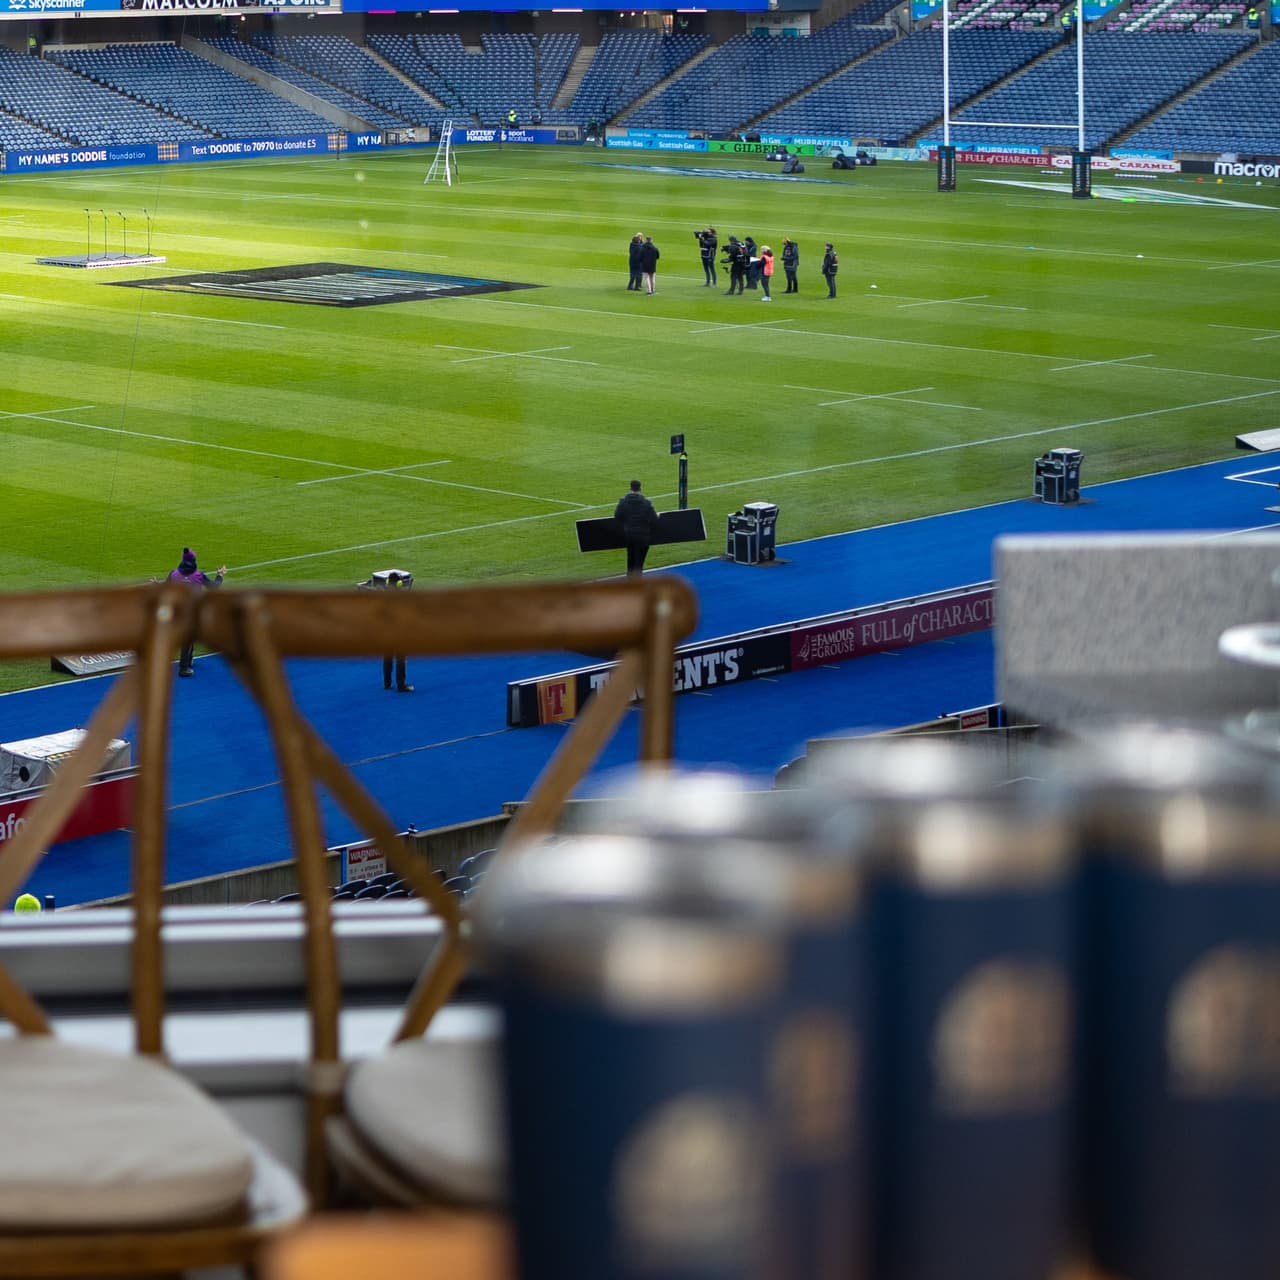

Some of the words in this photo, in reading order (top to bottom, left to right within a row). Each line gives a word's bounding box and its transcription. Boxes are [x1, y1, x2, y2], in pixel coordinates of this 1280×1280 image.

[191, 144, 207, 156] Text
[243, 141, 252, 153] to
[252, 141, 275, 153] 70970
[275, 140, 283, 152] to
[283, 139, 307, 151] donate
[793, 138, 849, 147] MURRAYFIELD
[18, 154, 33, 167] MY
[72, 149, 107, 163] DODDIE
[108, 149, 146, 161] foundation
[965, 154, 986, 163] FULL
[995, 156, 1049, 166] CHARACTER
[1119, 161, 1176, 171] CARAMEL
[817, 627, 855, 647] FAMOUS
[861, 617, 902, 646] FULL
[903, 613, 918, 643] of
[817, 637, 855, 659] GROUSE
